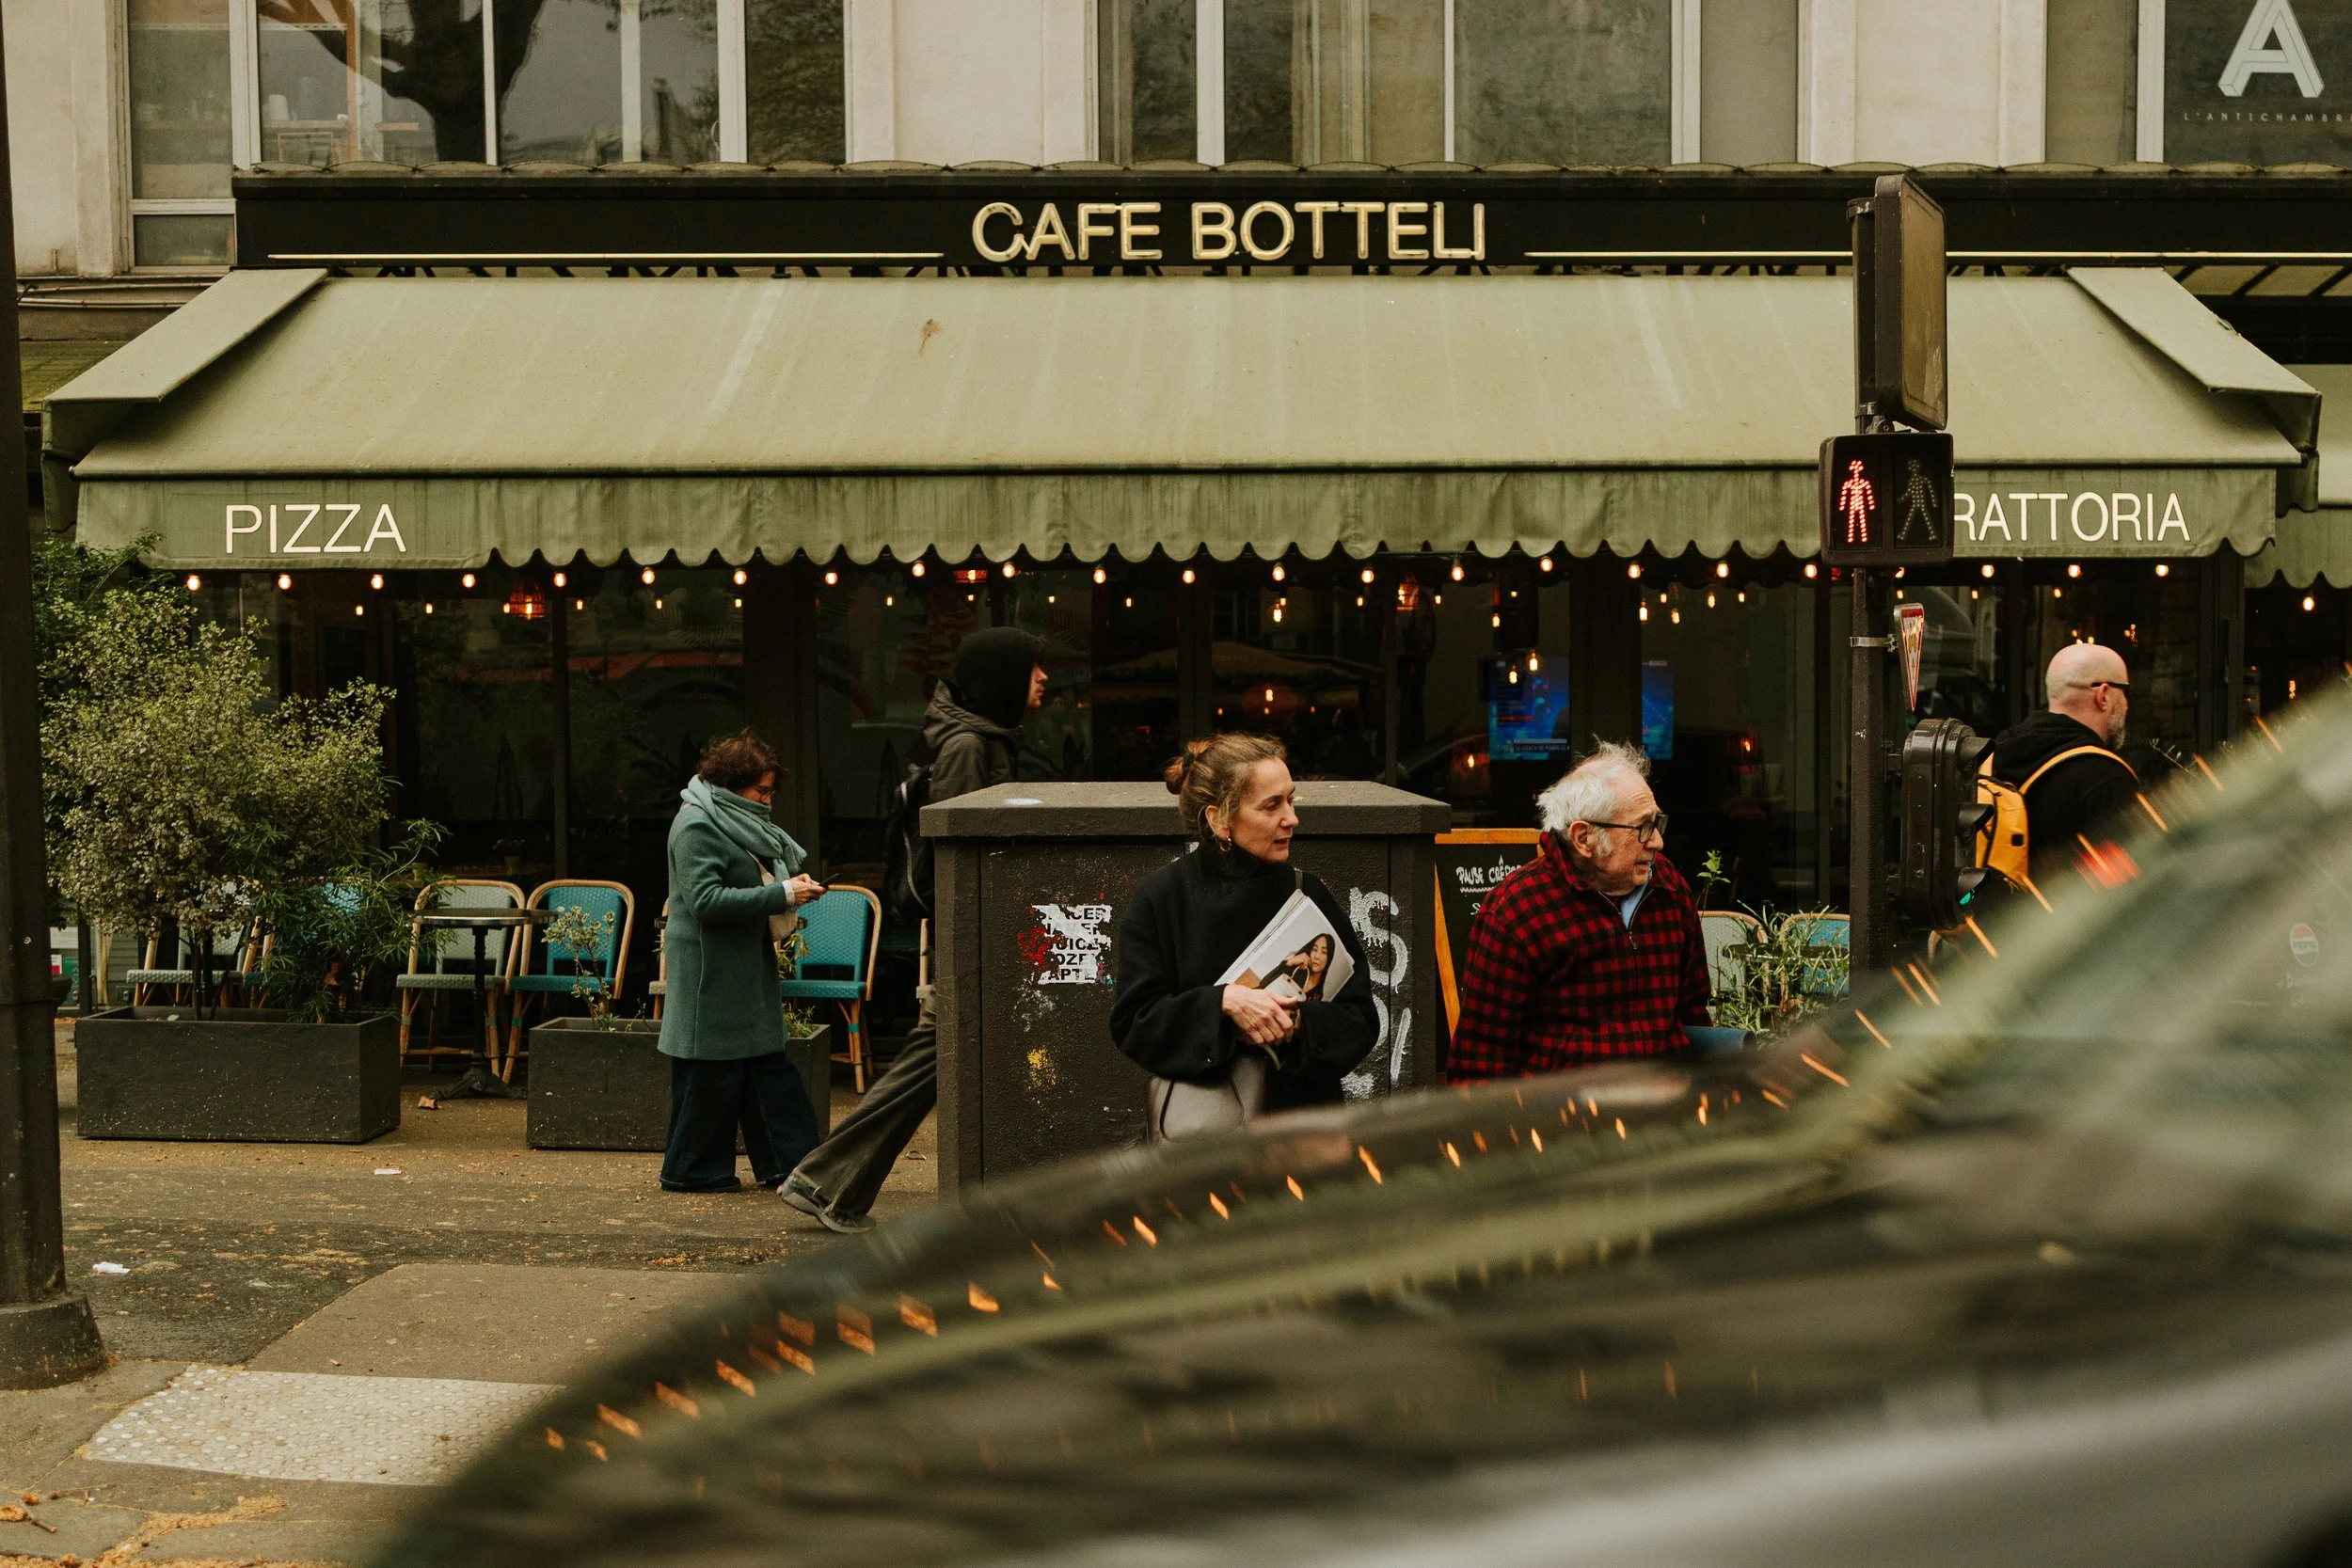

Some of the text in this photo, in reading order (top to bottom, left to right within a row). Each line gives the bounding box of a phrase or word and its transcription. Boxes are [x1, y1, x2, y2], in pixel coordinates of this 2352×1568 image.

[2217, 0, 2326, 98] A
[972, 200, 1486, 261] CAFE BOTTELI
[226, 503, 407, 554] PIZZA
[1954, 491, 2191, 542] RATTORIA
[1455, 854, 1522, 885] PAUSE CRÊP
